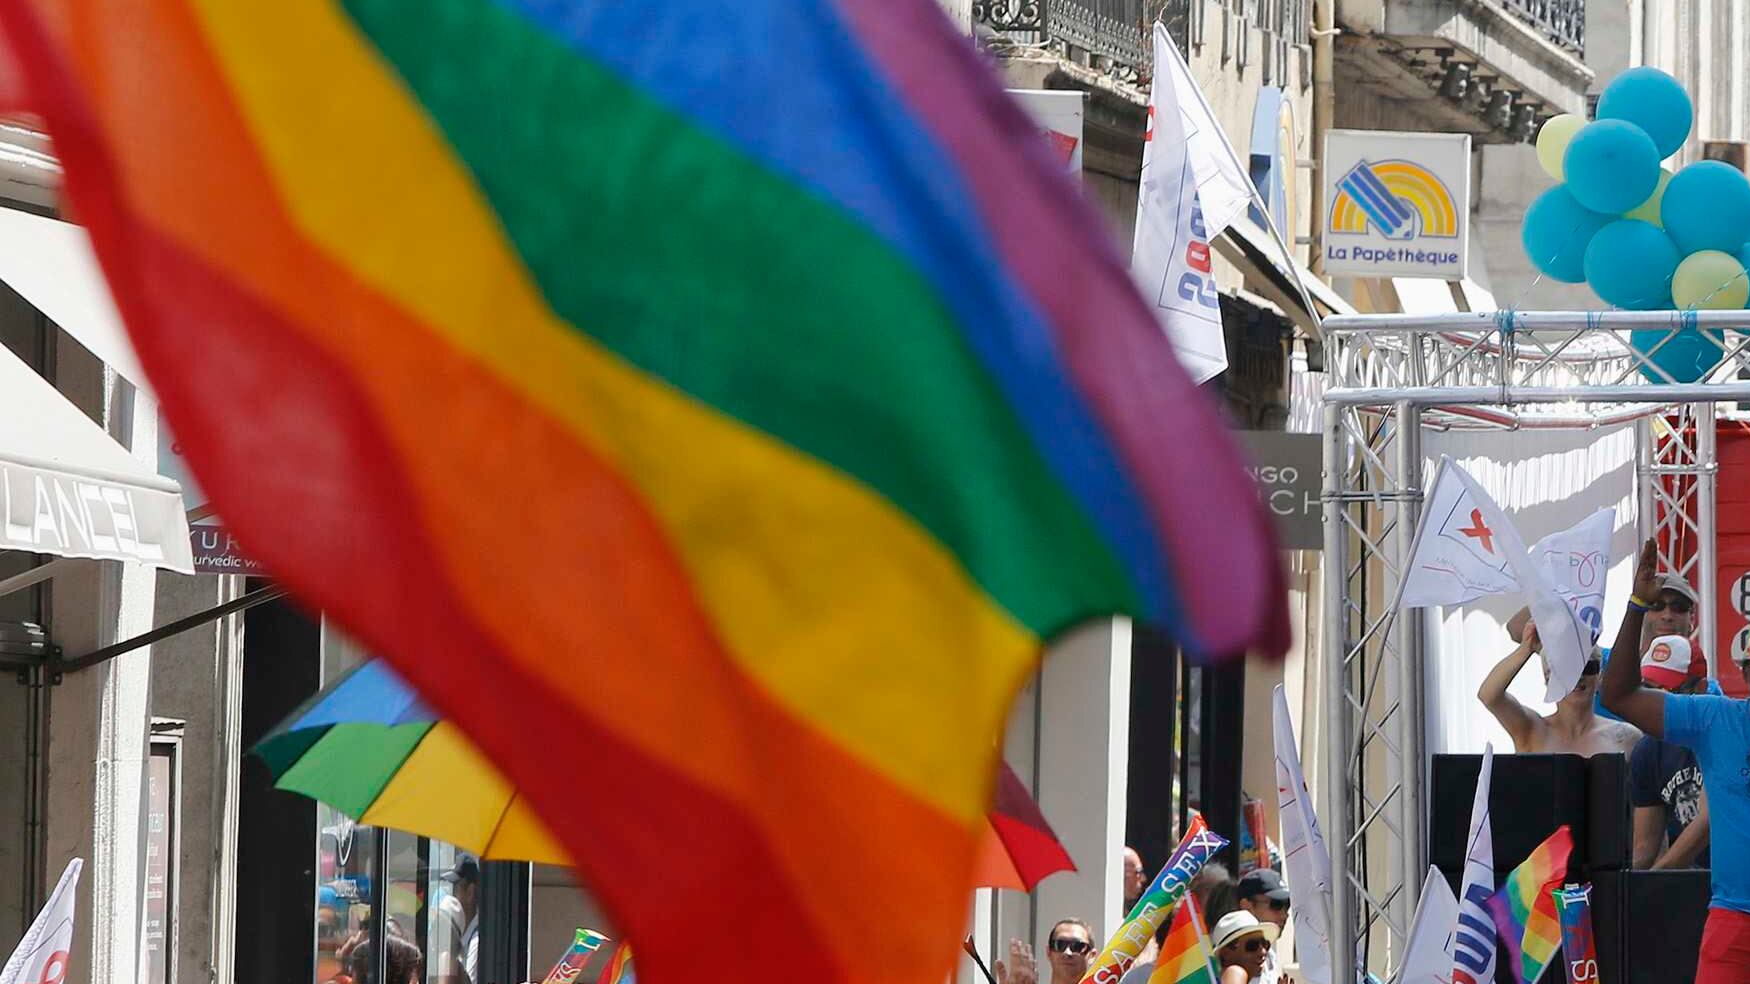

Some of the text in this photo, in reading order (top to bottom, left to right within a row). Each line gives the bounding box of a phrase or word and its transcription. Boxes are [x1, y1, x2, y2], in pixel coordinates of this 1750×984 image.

[1328, 244, 1458, 265] La Papéthèque
[4, 468, 164, 560] LANCEL
[1161, 825, 1223, 901] SEX
